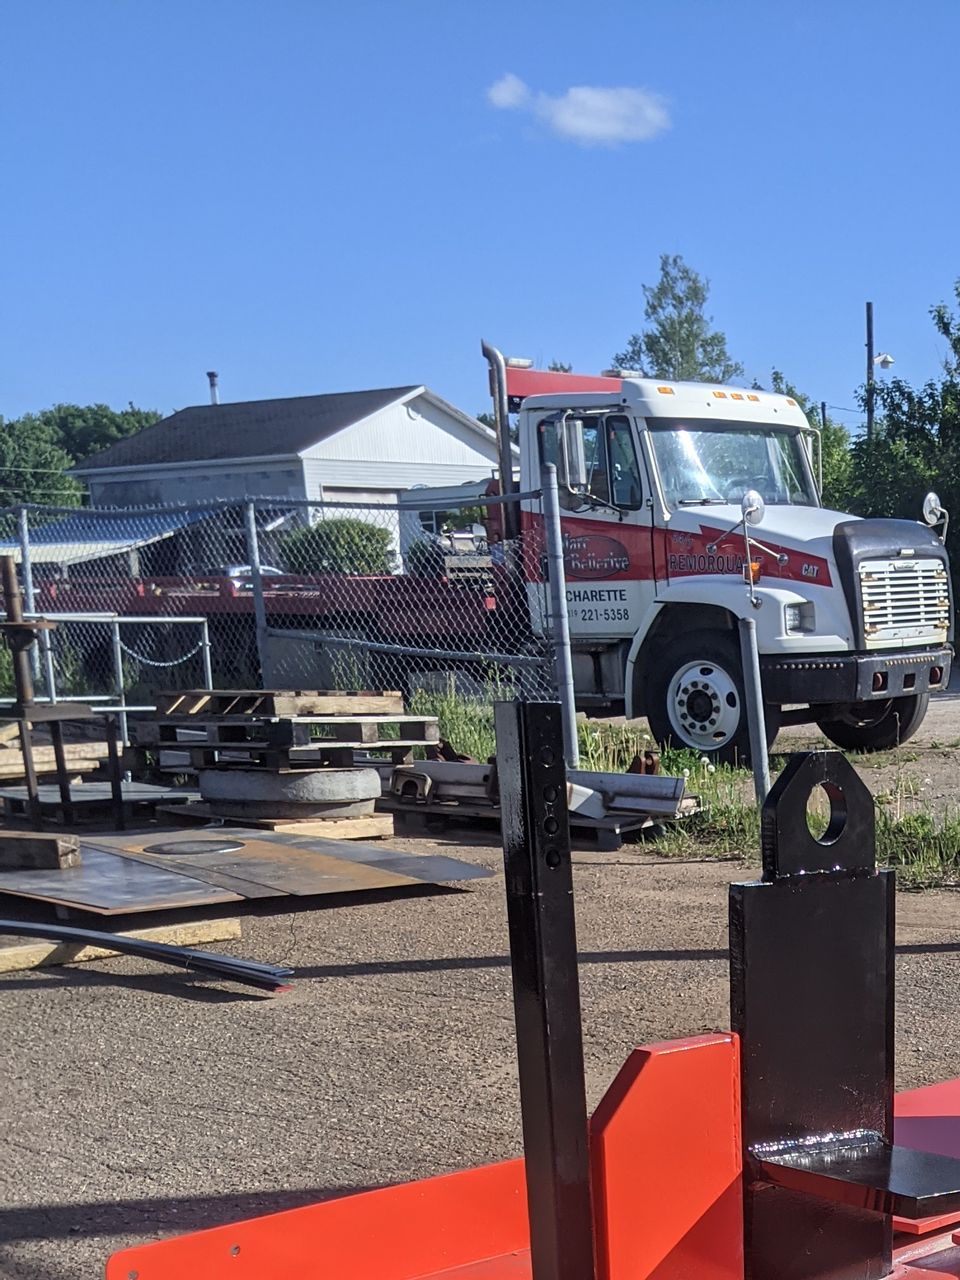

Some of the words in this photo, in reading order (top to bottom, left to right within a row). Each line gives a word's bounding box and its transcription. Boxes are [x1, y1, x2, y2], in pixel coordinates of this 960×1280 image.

[802, 563, 819, 577] CAT
[566, 589, 627, 602] CHARETTE
[581, 608, 630, 621] 221-5358
